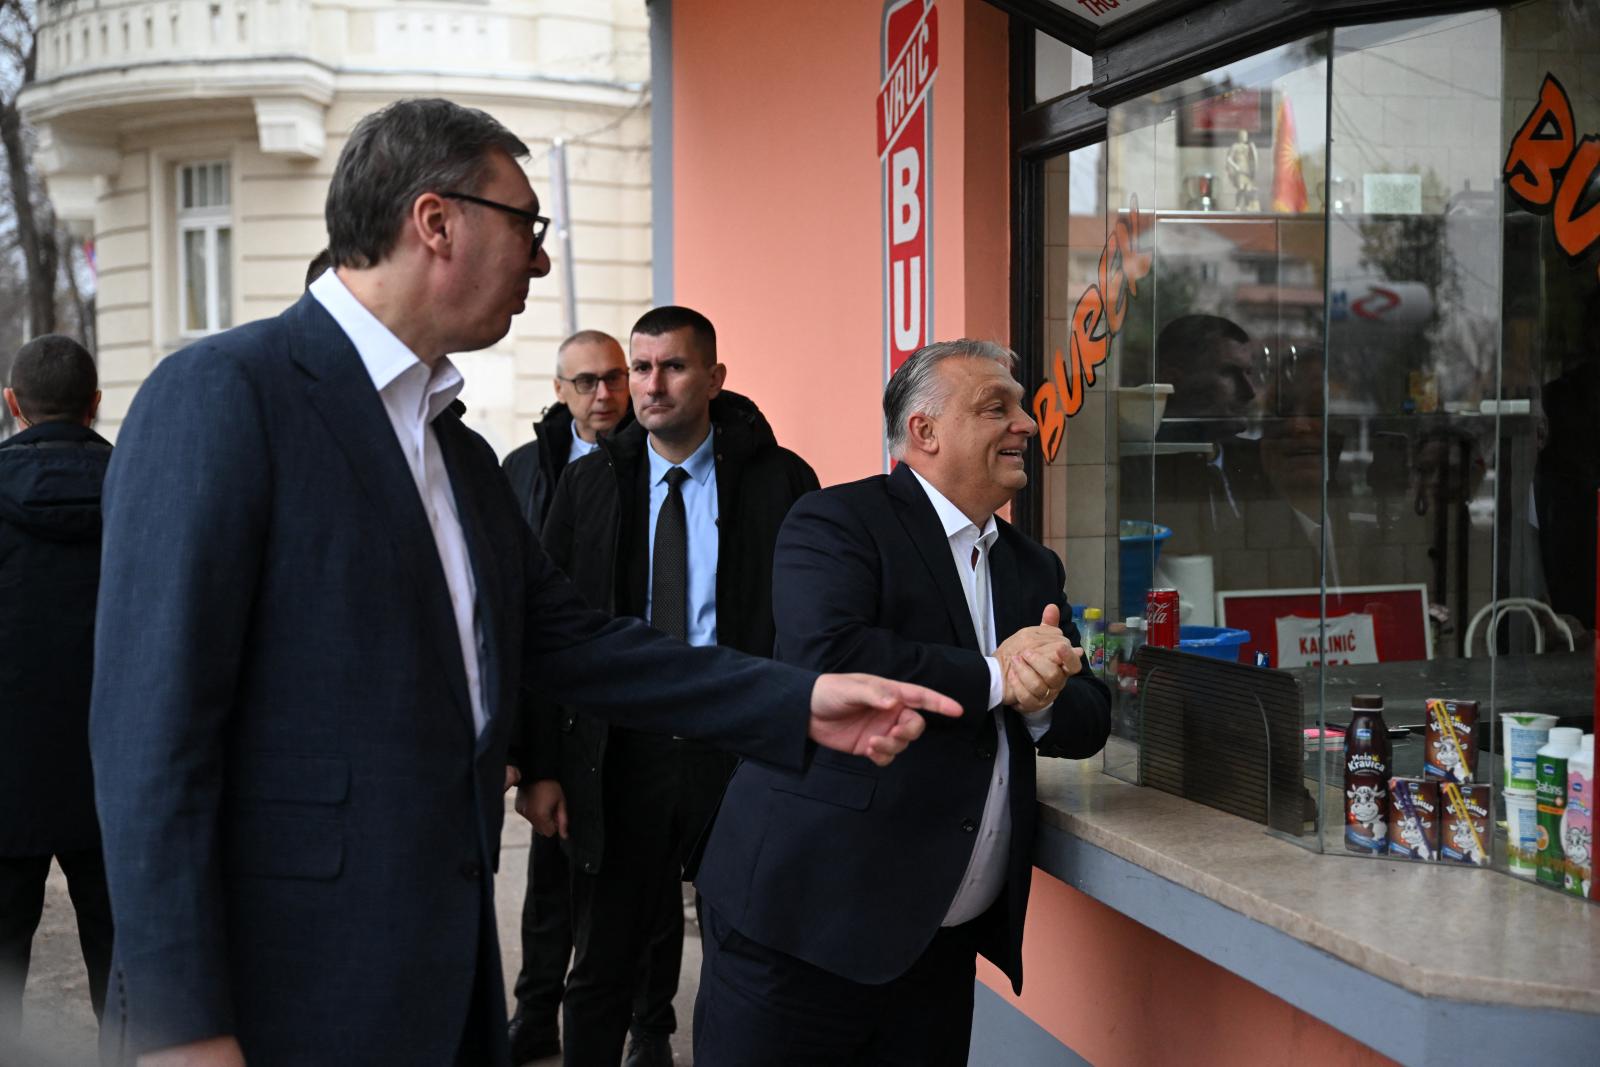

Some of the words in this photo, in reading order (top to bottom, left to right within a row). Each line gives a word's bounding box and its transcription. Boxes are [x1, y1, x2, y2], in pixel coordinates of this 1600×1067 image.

[892, 146, 921, 352] BU
[1503, 72, 1600, 268] BU
[1033, 192, 1152, 465] BUREK
[1347, 760, 1385, 772] Kravica
